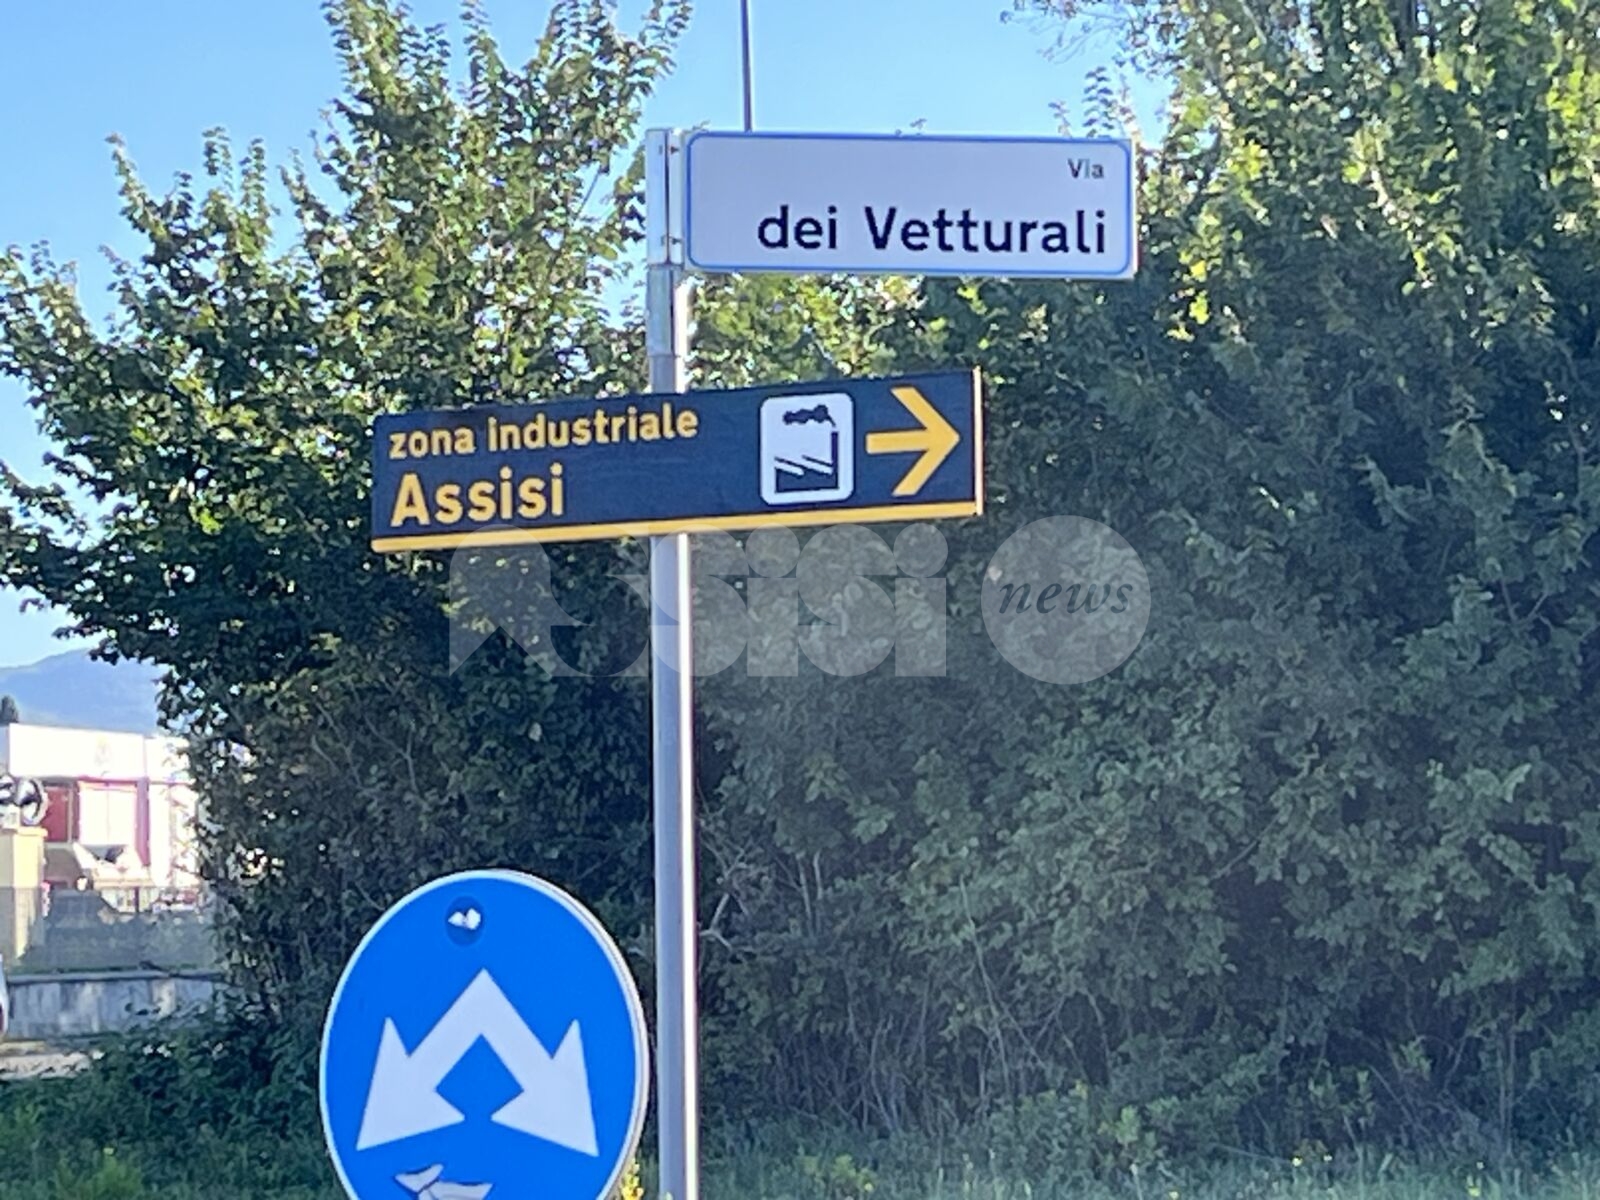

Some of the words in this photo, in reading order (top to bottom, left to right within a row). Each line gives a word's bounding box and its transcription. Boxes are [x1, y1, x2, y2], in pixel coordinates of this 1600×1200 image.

[1067, 158, 1105, 179] Via
[757, 205, 838, 251] dei
[864, 206, 1106, 254] Vetturali
[388, 427, 476, 459] zona
[488, 402, 699, 453] industriale
[389, 463, 566, 528] Assisi
